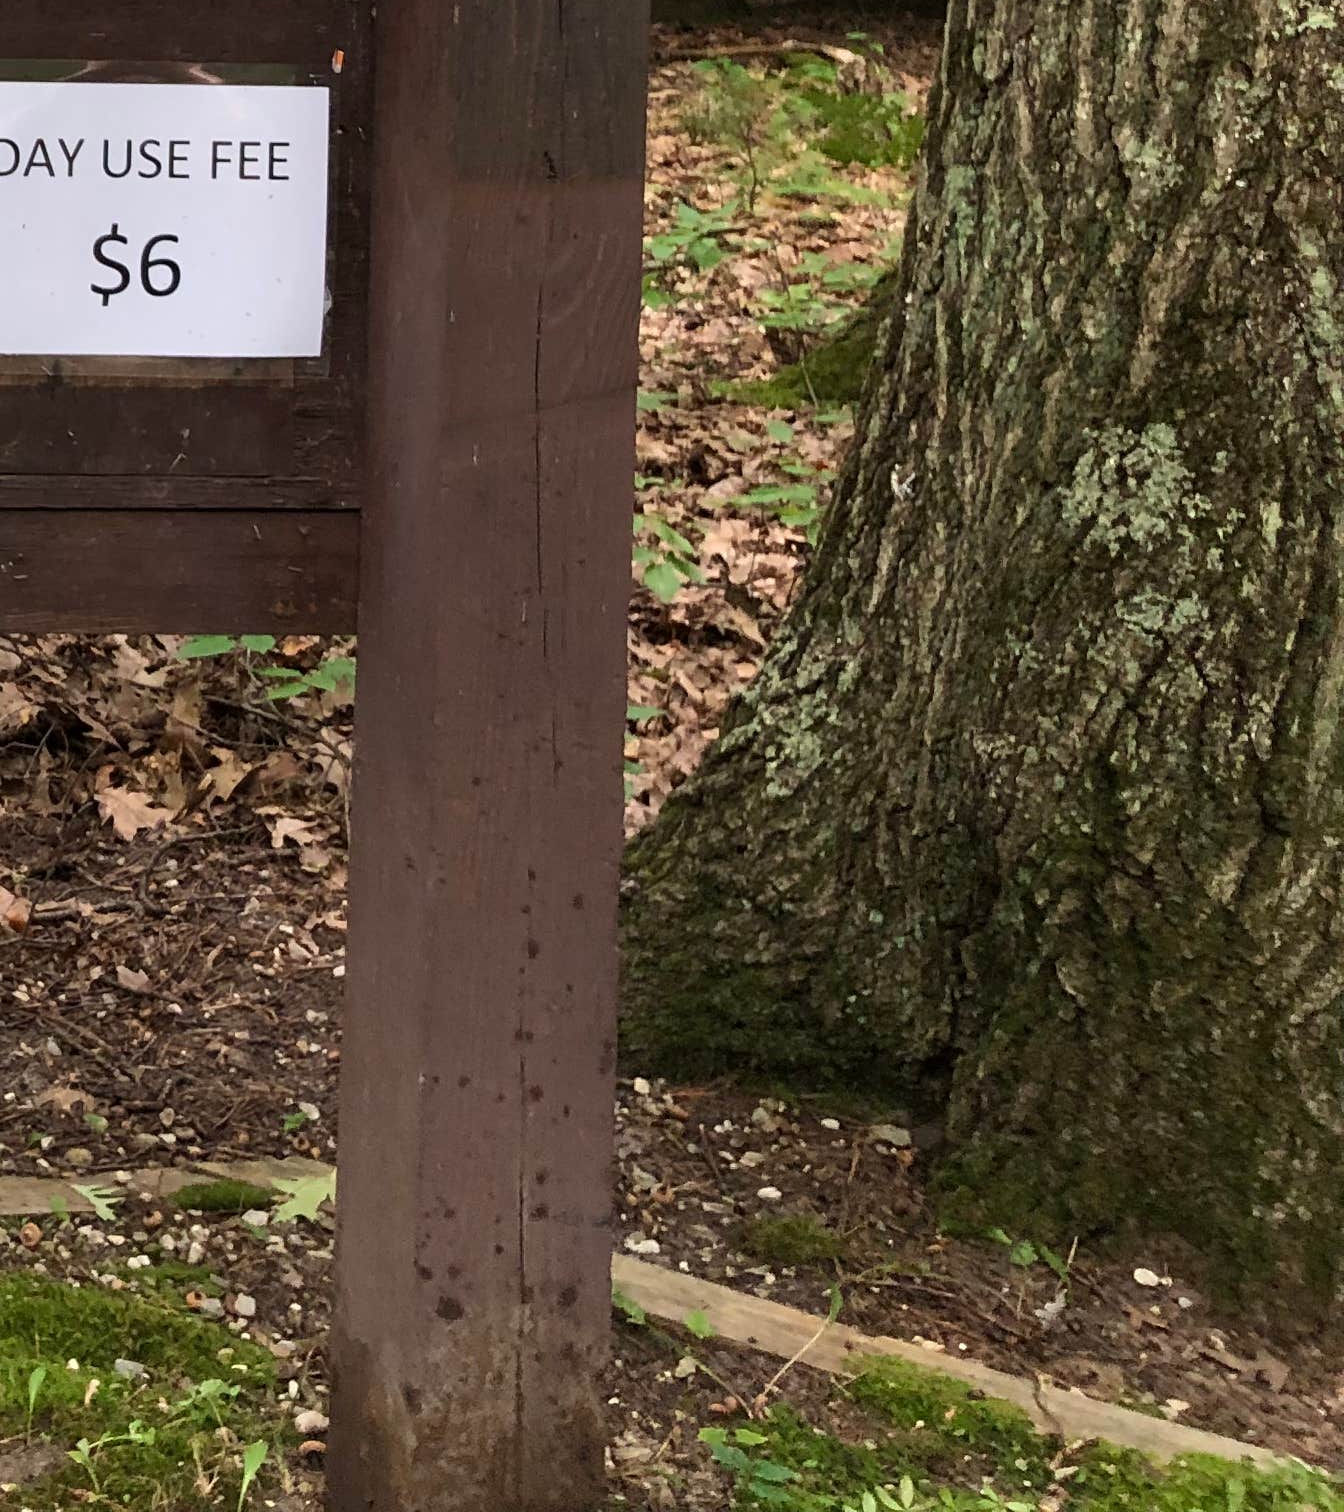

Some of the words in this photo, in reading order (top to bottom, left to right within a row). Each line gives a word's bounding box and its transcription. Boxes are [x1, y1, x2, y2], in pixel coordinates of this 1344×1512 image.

[102, 139, 190, 179] USE
[212, 141, 289, 180] FEE
[90, 223, 181, 306] $6
